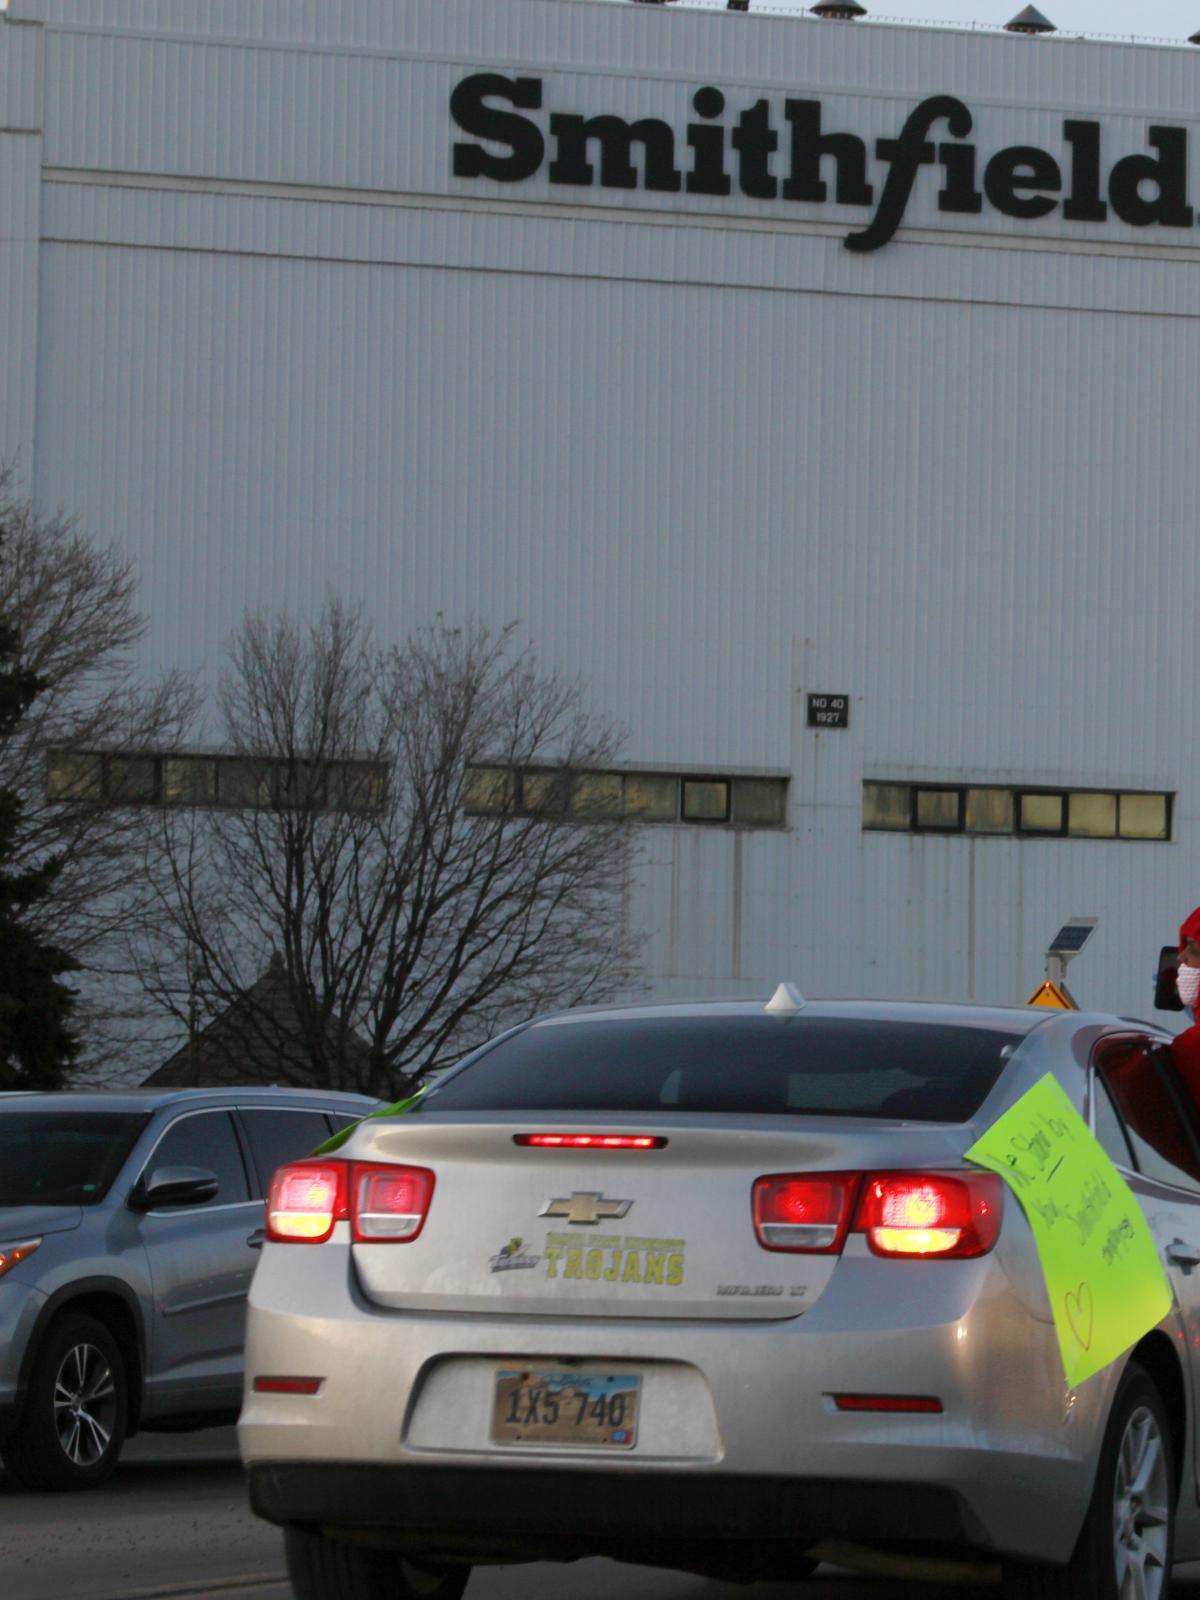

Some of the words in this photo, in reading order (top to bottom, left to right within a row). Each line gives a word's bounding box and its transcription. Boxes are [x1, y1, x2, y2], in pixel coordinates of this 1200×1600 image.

[449, 72, 1194, 252] Smithfield
[816, 711, 840, 723] 1927
[831, 699, 844, 709] 40
[545, 1250, 685, 1286] TROJANS
[573, 1391, 626, 1427] 740
